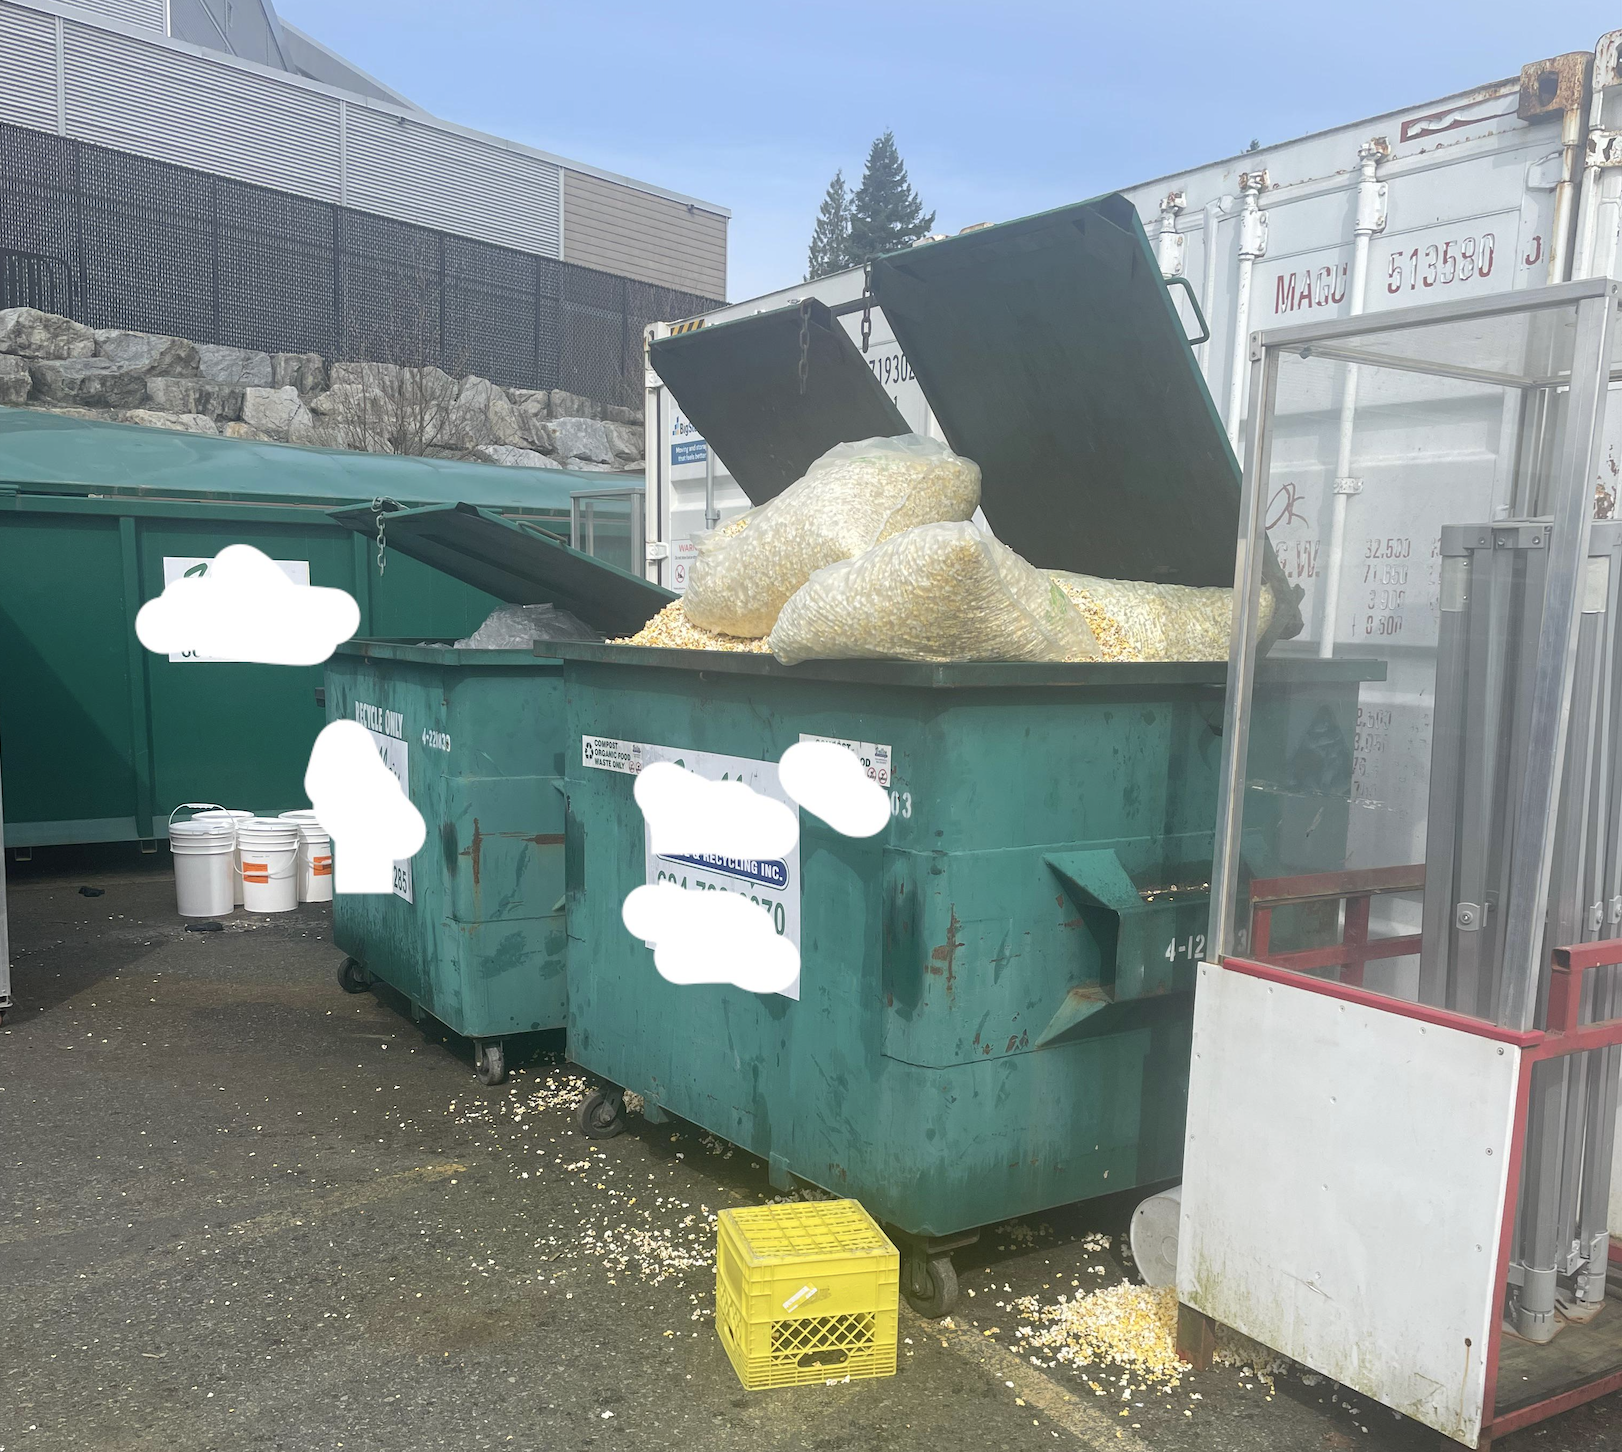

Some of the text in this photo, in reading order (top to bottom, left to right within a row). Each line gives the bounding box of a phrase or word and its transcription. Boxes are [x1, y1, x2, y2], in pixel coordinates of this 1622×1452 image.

[1274, 262, 1348, 314] MAGU
[1387, 233, 1495, 294] 513580
[355, 700, 404, 739] RECYCLE ONLY
[594, 739, 618, 750] COMPOST
[594, 748, 631, 761] ORGANIC FOOD
[594, 757, 626, 770] WASTE ONLY
[703, 853, 759, 875] RECYCLING
[761, 862, 784, 882] INC.
